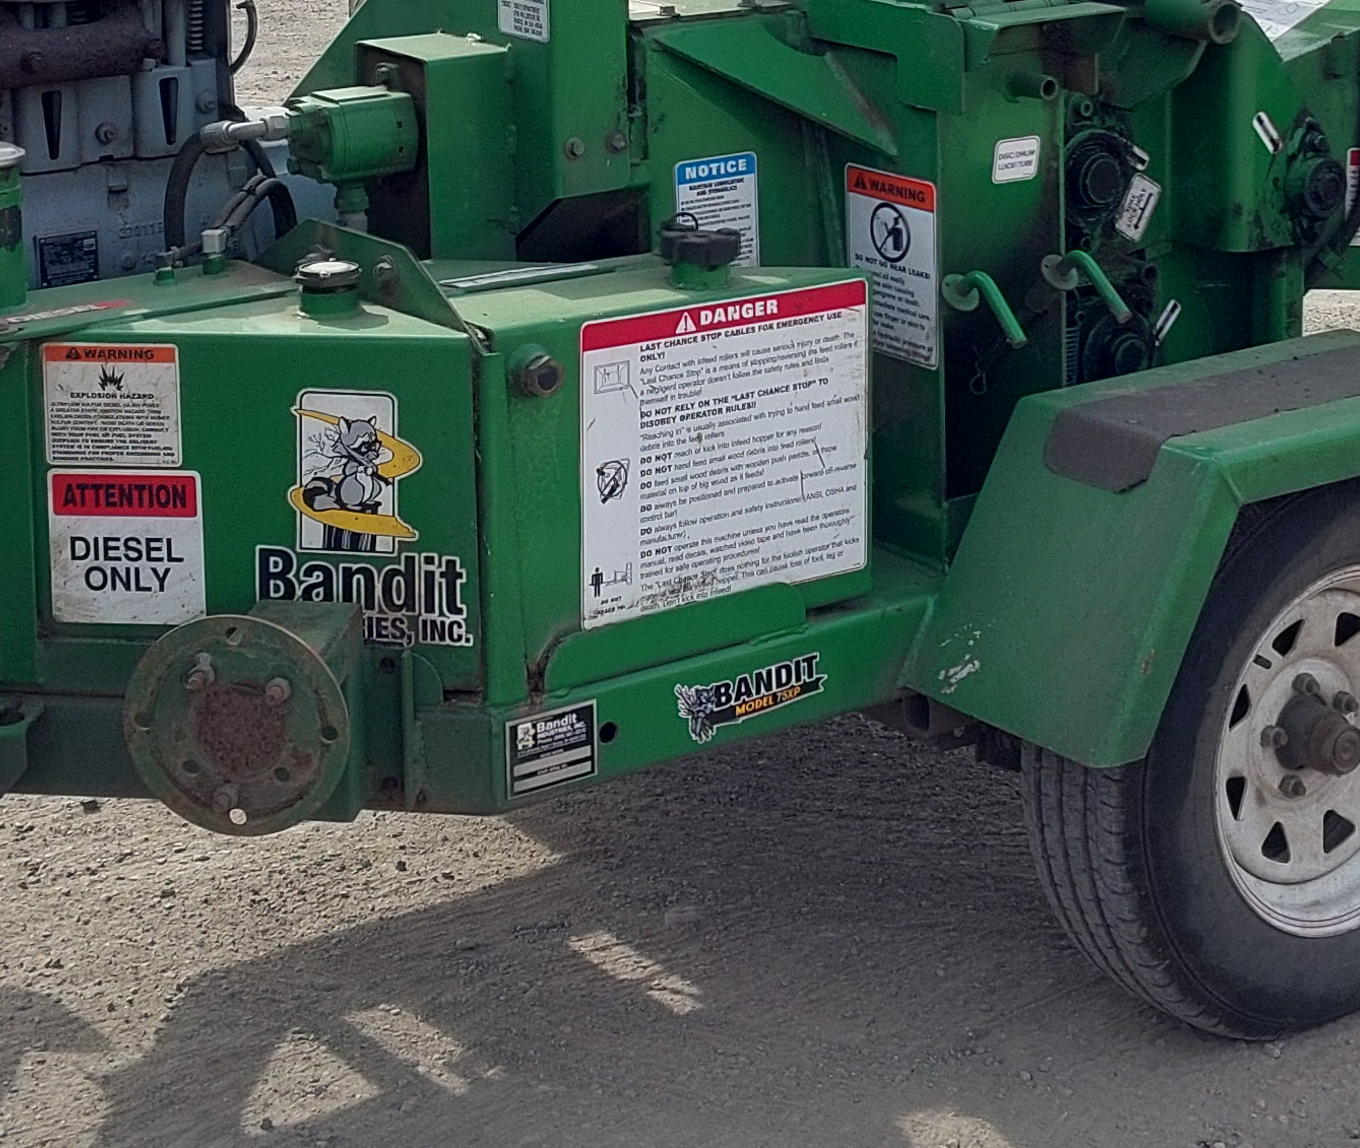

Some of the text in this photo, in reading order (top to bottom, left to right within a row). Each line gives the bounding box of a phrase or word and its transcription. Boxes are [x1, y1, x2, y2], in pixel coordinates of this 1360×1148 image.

[685, 158, 747, 180] NOTICE
[868, 176, 926, 204] WARNING
[854, 253, 930, 280] DO NOT GO NEAR LEAKS!
[699, 299, 779, 327] DANGER
[639, 311, 842, 352] LAST CHANCE STOP CABLES FOR EMERGENCY USE
[83, 348, 155, 360] WARNING
[639, 351, 666, 362] ONLY!
[70, 392, 154, 400] EXPLOSION HAZARD
[639, 409, 652, 418] DO
[653, 405, 672, 416] NOT
[673, 401, 696, 412] RELY
[697, 398, 710, 408] ON
[711, 395, 729, 405] THE
[756, 384, 790, 397] CHANCE
[817, 377, 828, 386] TO
[639, 415, 677, 429] DISOBEY
[678, 407, 723, 422] OPERATOR
[639, 455, 652, 465] DO
[654, 451, 672, 462] NOT
[639, 464, 672, 477] DO NOT
[63, 483, 187, 509] ATTENTION
[639, 480, 652, 490] DO
[639, 503, 653, 513] DO
[639, 526, 653, 536] DO
[70, 536, 184, 563] DIESEL
[639, 544, 672, 559] DO NOT
[84, 566, 171, 592] ONLY
[256, 545, 466, 619] Bandit
[418, 616, 474, 646] INC.
[714, 652, 819, 709] BANDIT
[735, 686, 801, 717] MODEL 75XP
[536, 713, 577, 733] Bandit
